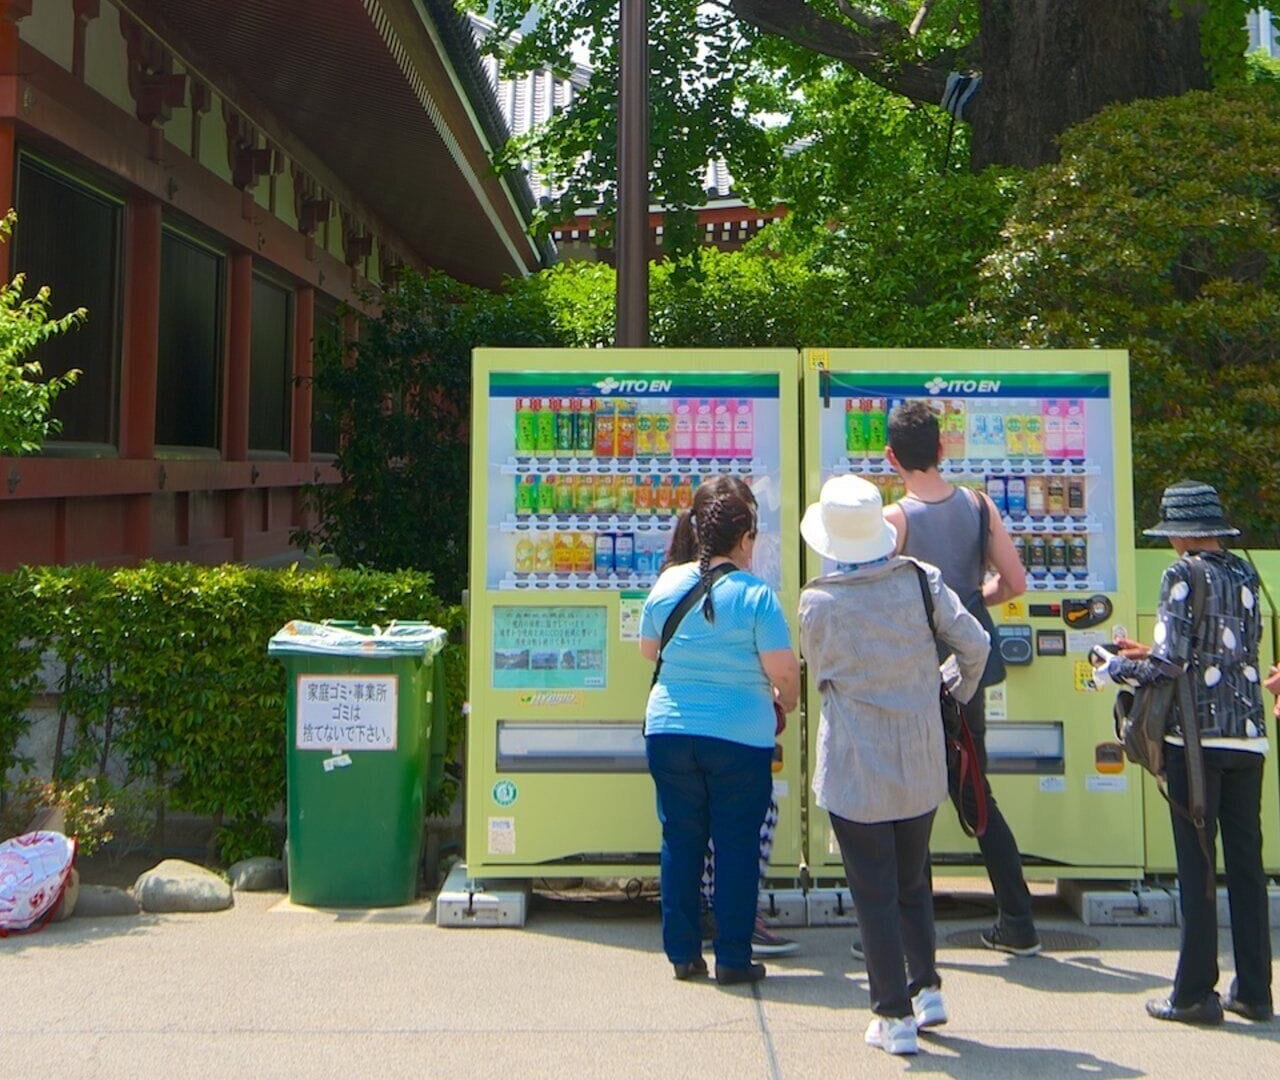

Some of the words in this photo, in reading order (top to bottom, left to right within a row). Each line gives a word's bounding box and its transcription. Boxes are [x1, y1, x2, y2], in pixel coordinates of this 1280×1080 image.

[618, 380, 647, 393] ITO
[648, 380, 672, 393] EN
[947, 380, 976, 393] ITO
[977, 380, 1001, 393] EN
[307, 682, 387, 702] 家庭ゴミ・事業所
[332, 703, 361, 722] ゴミは
[303, 723, 392, 743] 捨てないで下さい。
